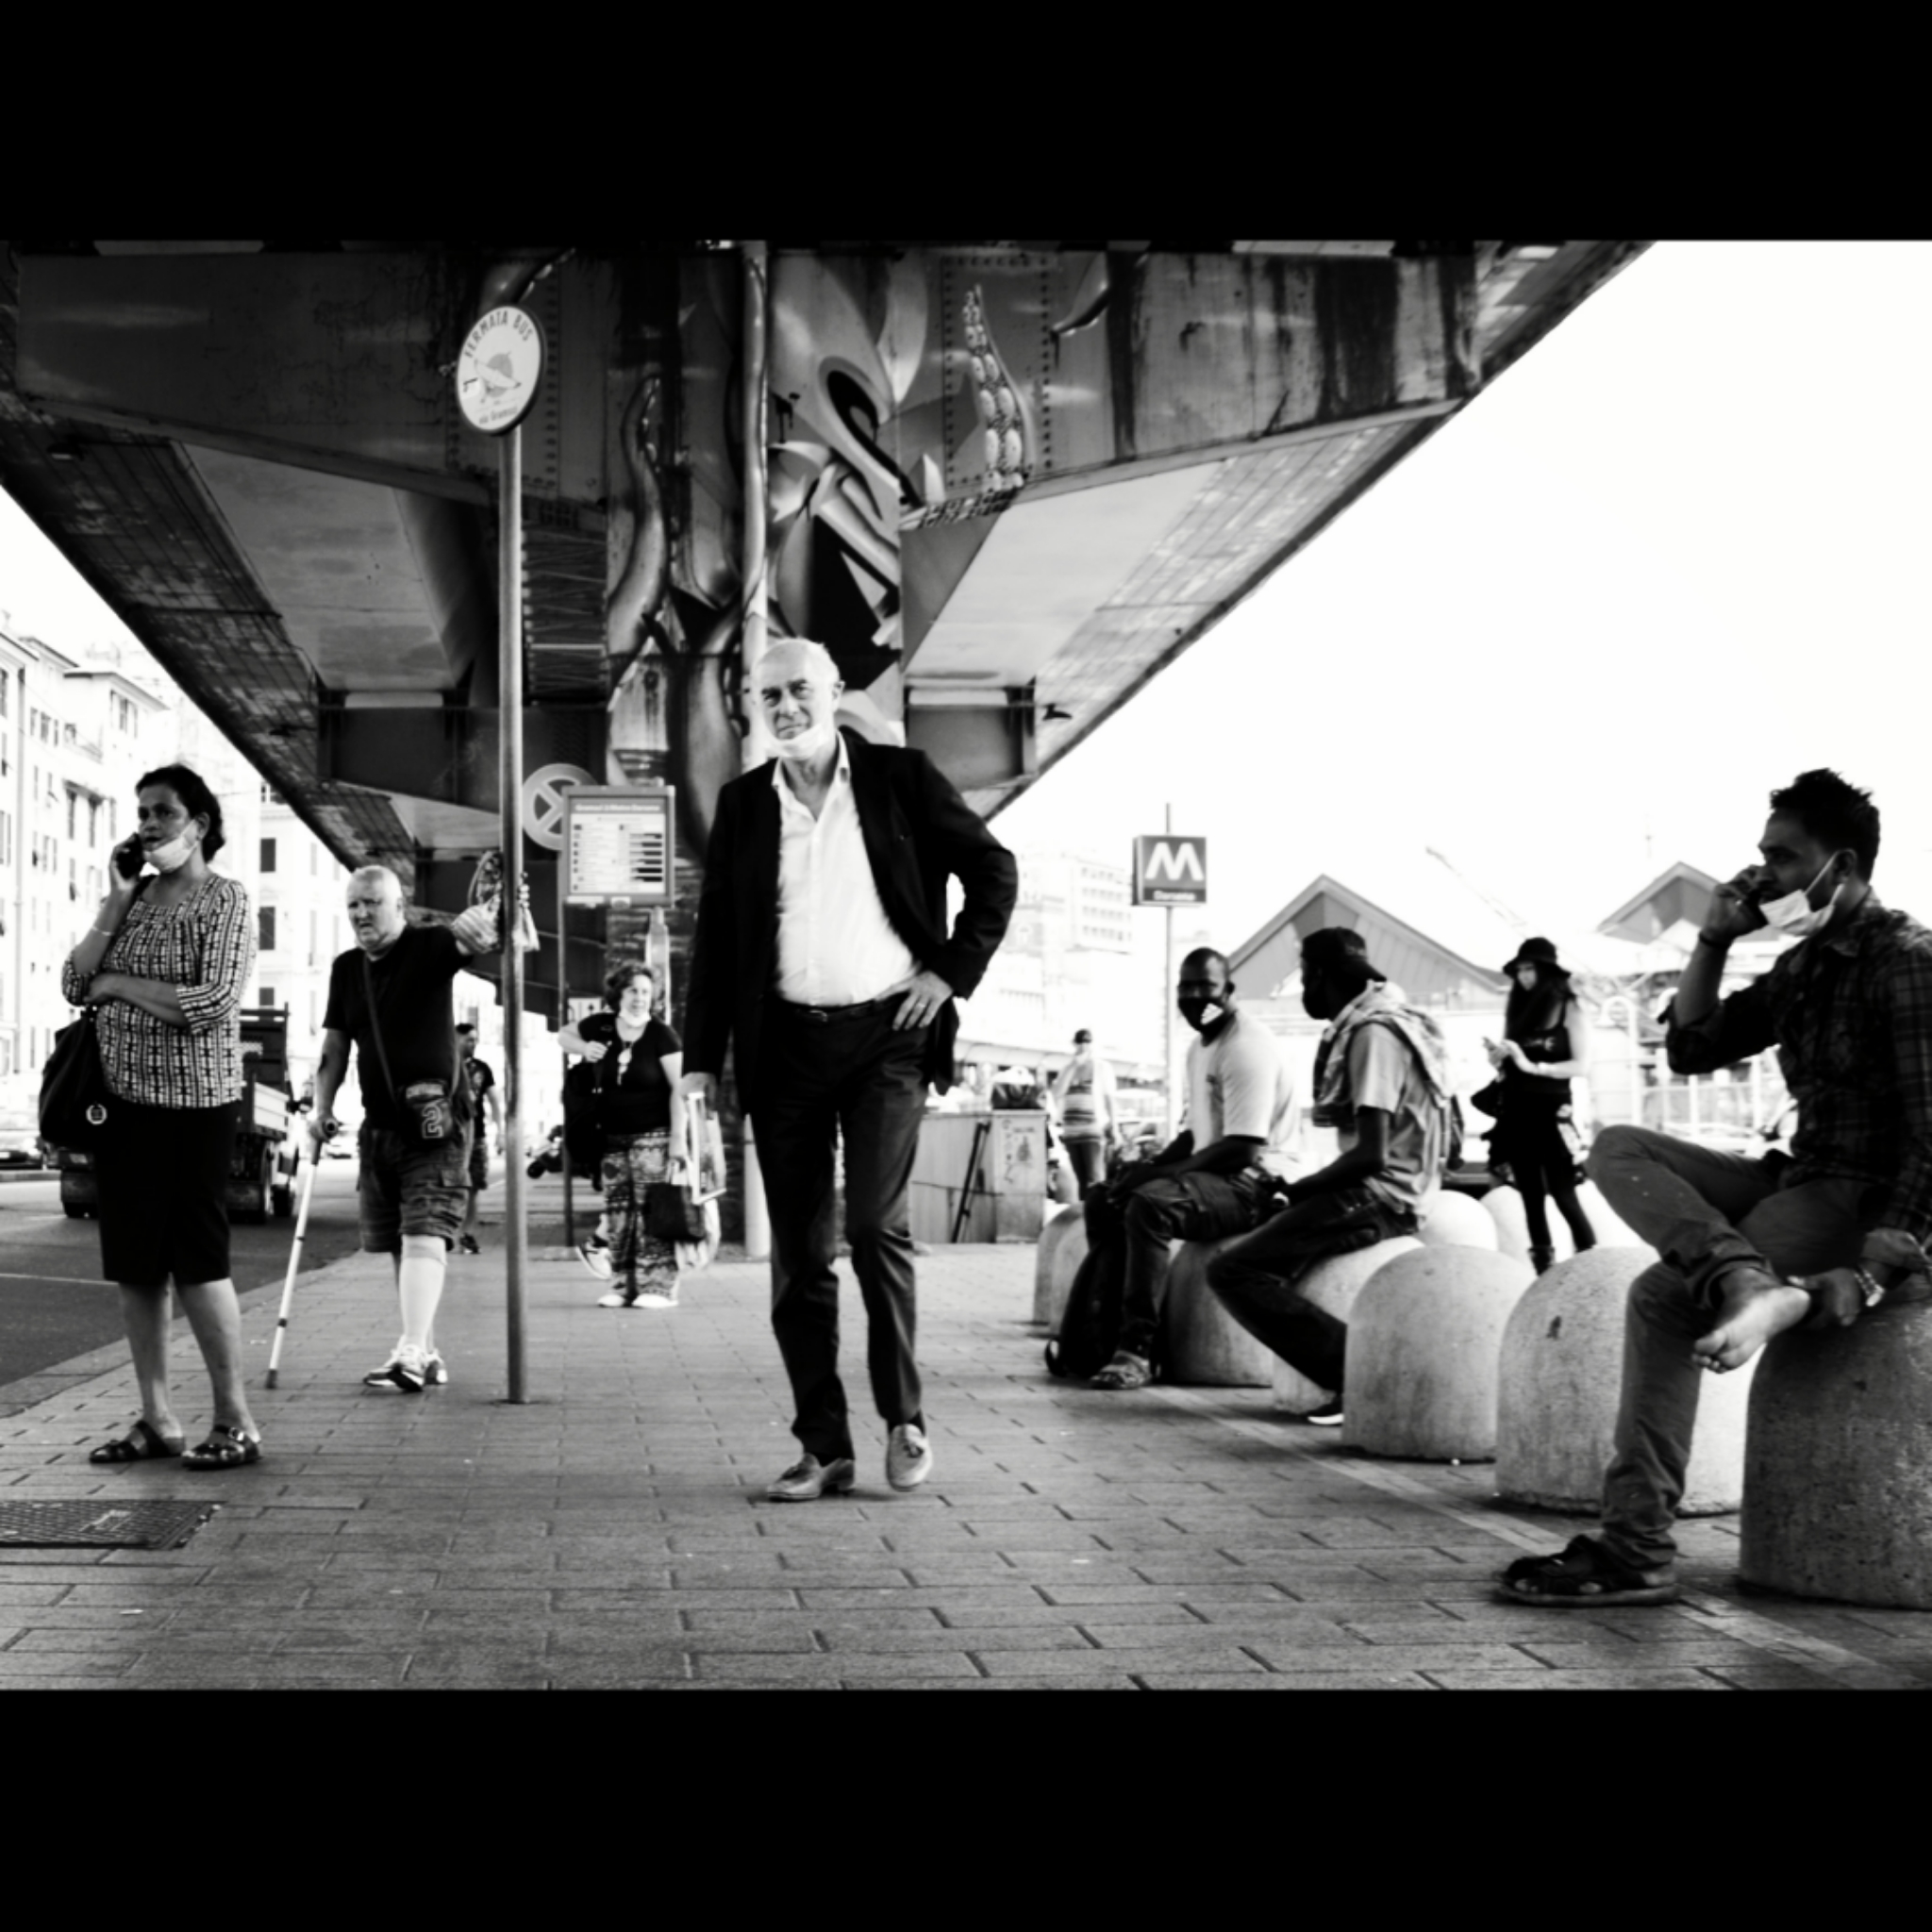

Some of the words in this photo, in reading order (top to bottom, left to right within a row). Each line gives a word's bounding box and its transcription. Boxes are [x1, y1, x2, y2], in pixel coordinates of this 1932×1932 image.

[464, 310, 508, 358] FERMATA
[512, 314, 533, 341] BUS
[1144, 841, 1204, 881] M
